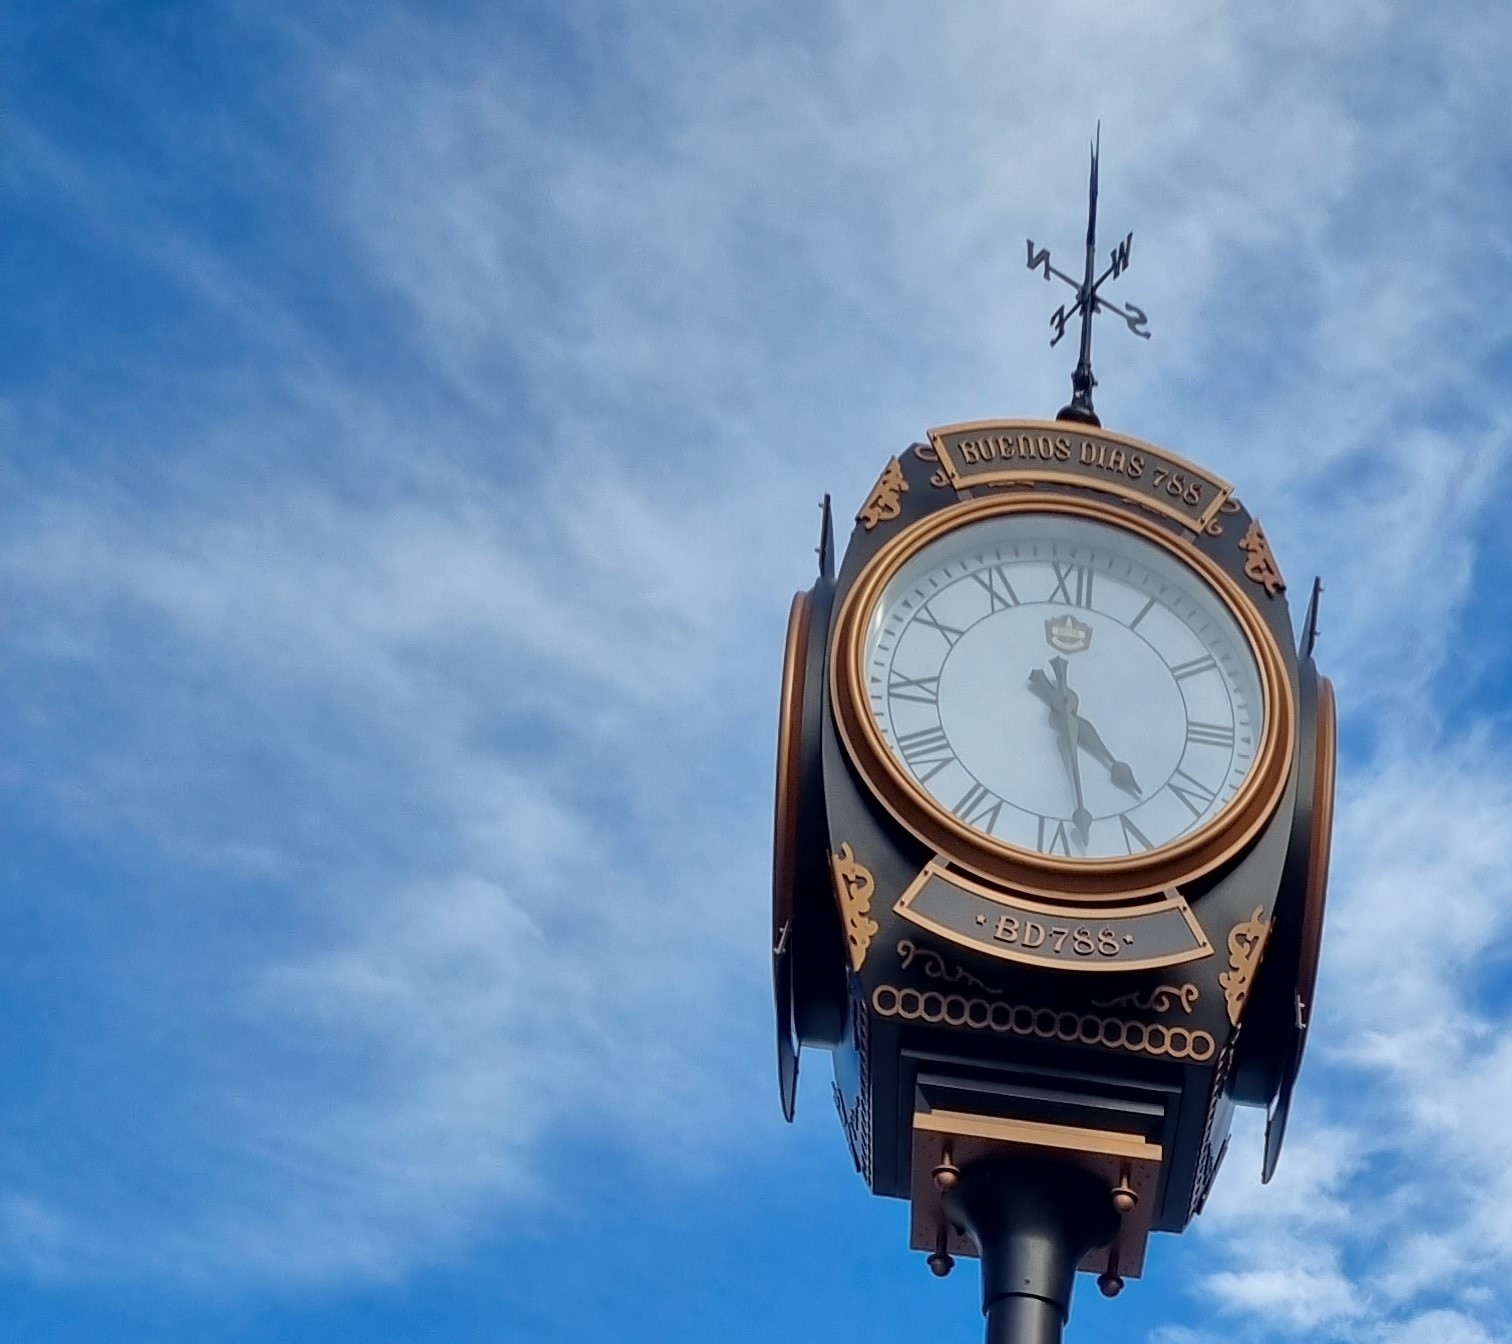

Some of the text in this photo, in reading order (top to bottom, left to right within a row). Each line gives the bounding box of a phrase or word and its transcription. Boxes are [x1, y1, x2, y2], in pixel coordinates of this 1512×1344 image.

[958, 435, 1203, 505] BUENOS DIAS 788
[1048, 561, 1095, 610] XII
[914, 603, 965, 648] X
[994, 915, 1121, 957] BD788
